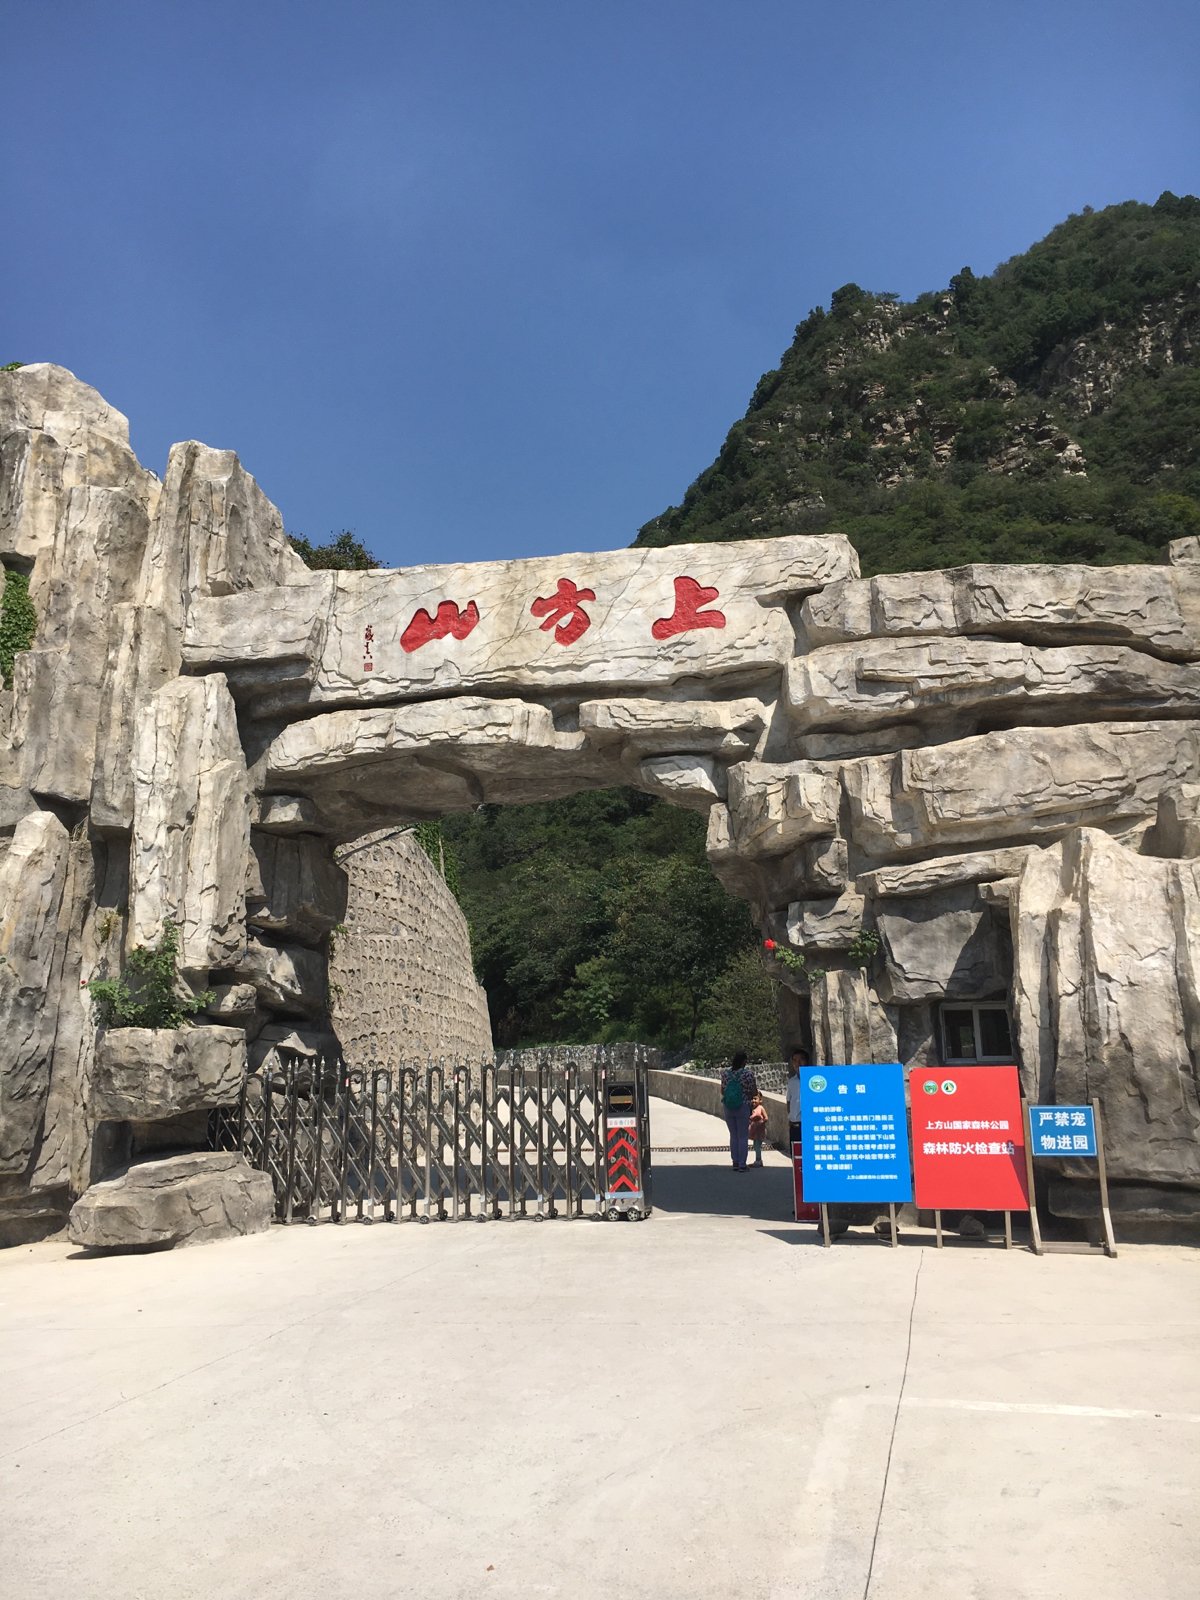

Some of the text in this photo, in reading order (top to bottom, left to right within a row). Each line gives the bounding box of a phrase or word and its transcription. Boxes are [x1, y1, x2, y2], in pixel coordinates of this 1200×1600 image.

[925, 1120, 1009, 1130] 上方山国家森林公园
[1039, 1111, 1087, 1127] 严禁宠
[923, 1141, 1014, 1155] 森林防火检查站
[1041, 1134, 1088, 1150] 物进园
